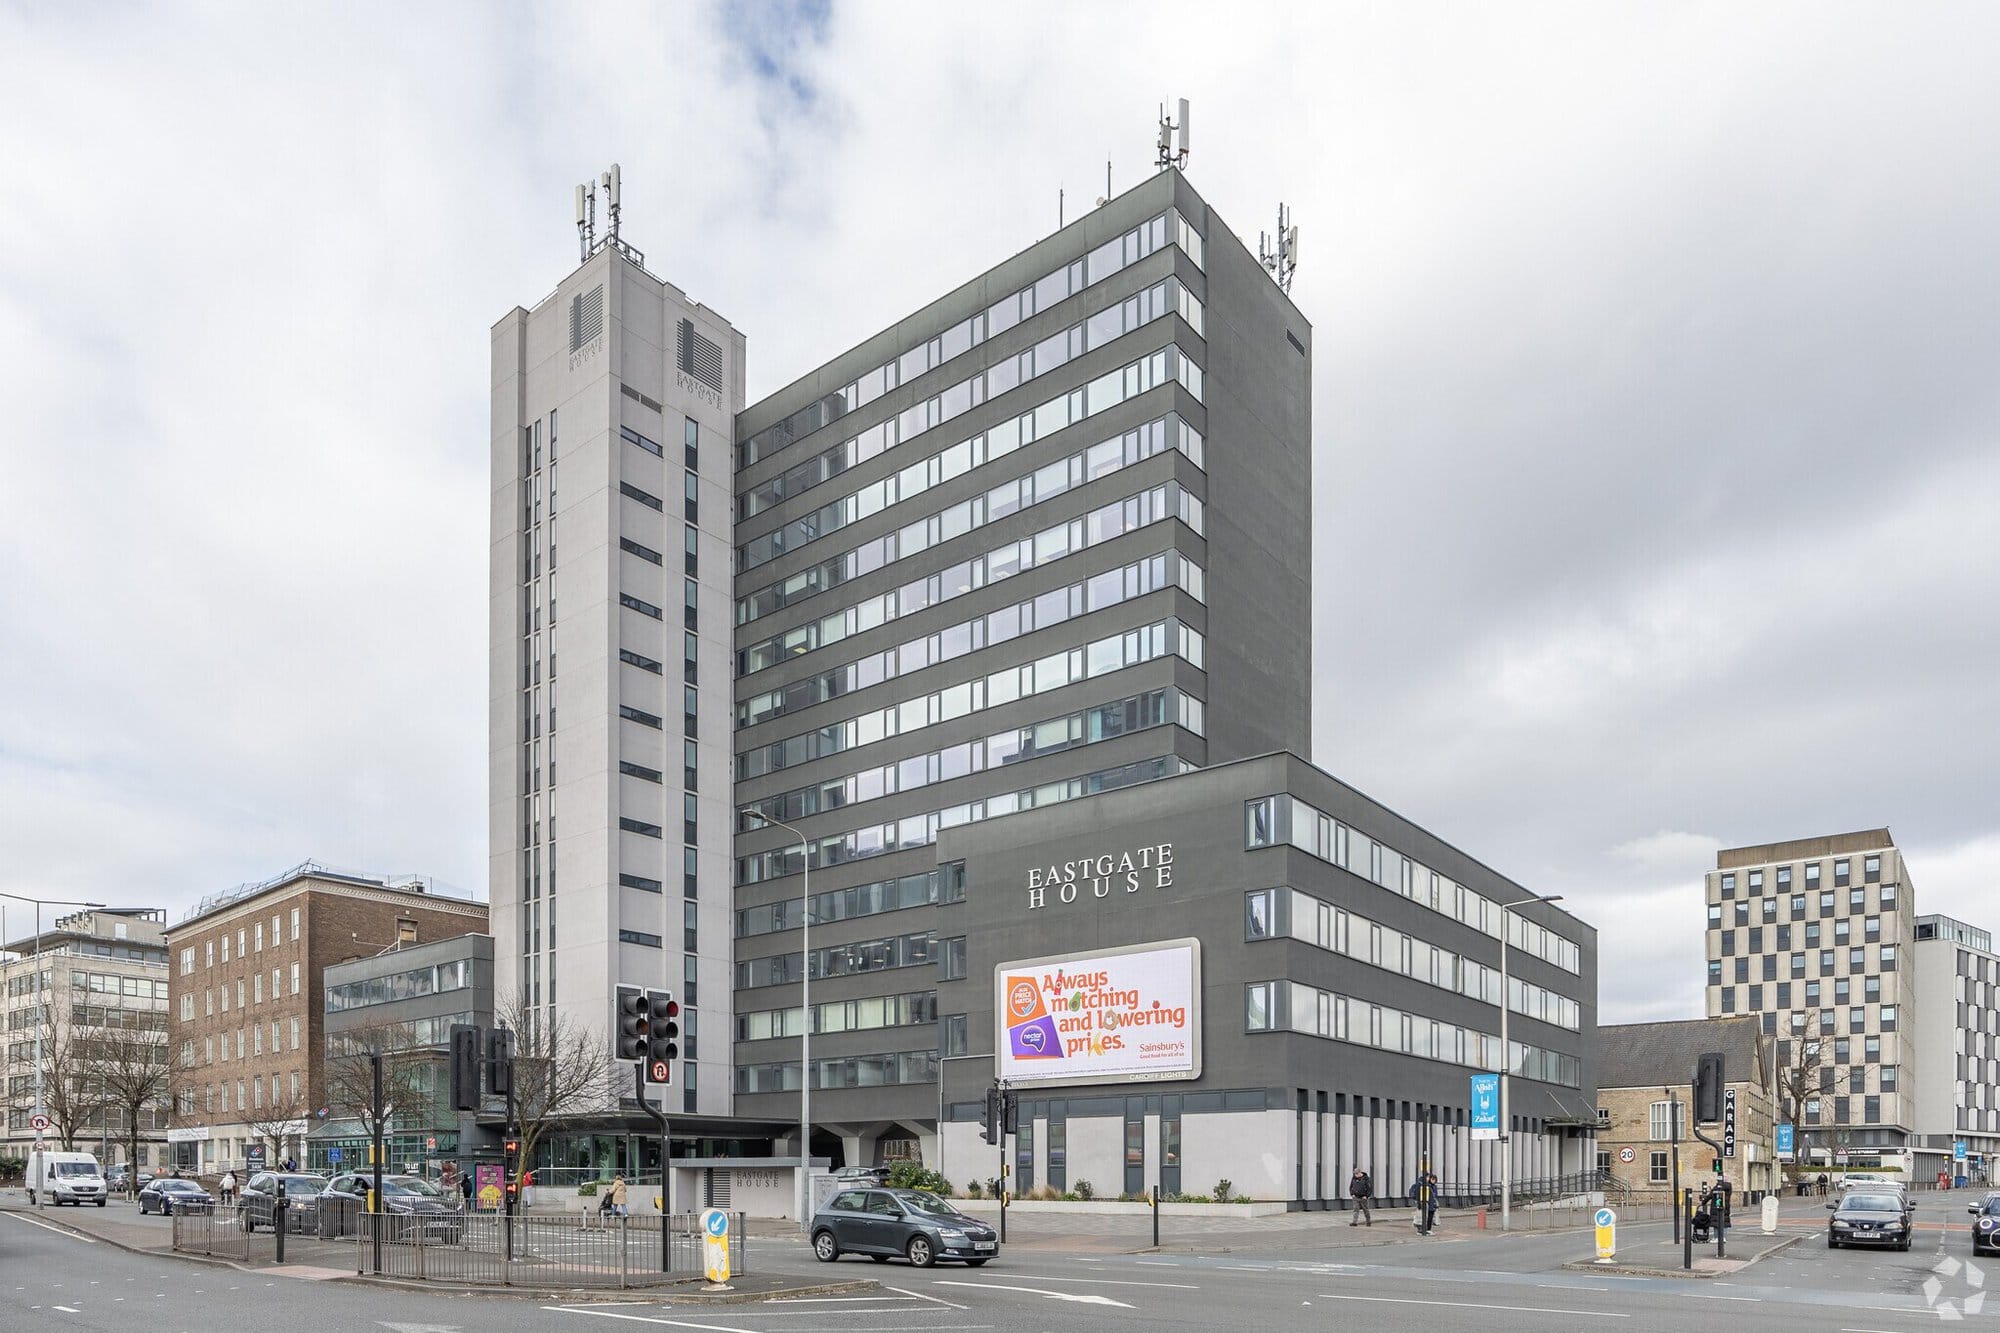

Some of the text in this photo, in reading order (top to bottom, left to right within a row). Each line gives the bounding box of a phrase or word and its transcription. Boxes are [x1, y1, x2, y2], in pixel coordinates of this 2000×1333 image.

[677, 371, 722, 402] EASTGATE
[677, 378, 722, 410] HOUSE
[1028, 843, 1173, 889] EASTGATE
[1028, 866, 1173, 909] HOUSE
[1059, 1012, 1092, 1032] and
[1023, 1032, 1041, 1040] nectar
[1140, 1041, 1185, 1052] Sainsbury's
[1725, 1090, 1734, 1155] GARAGE
[736, 1170, 779, 1179] EASTGATE
[736, 1180, 779, 1188] HOUSE
